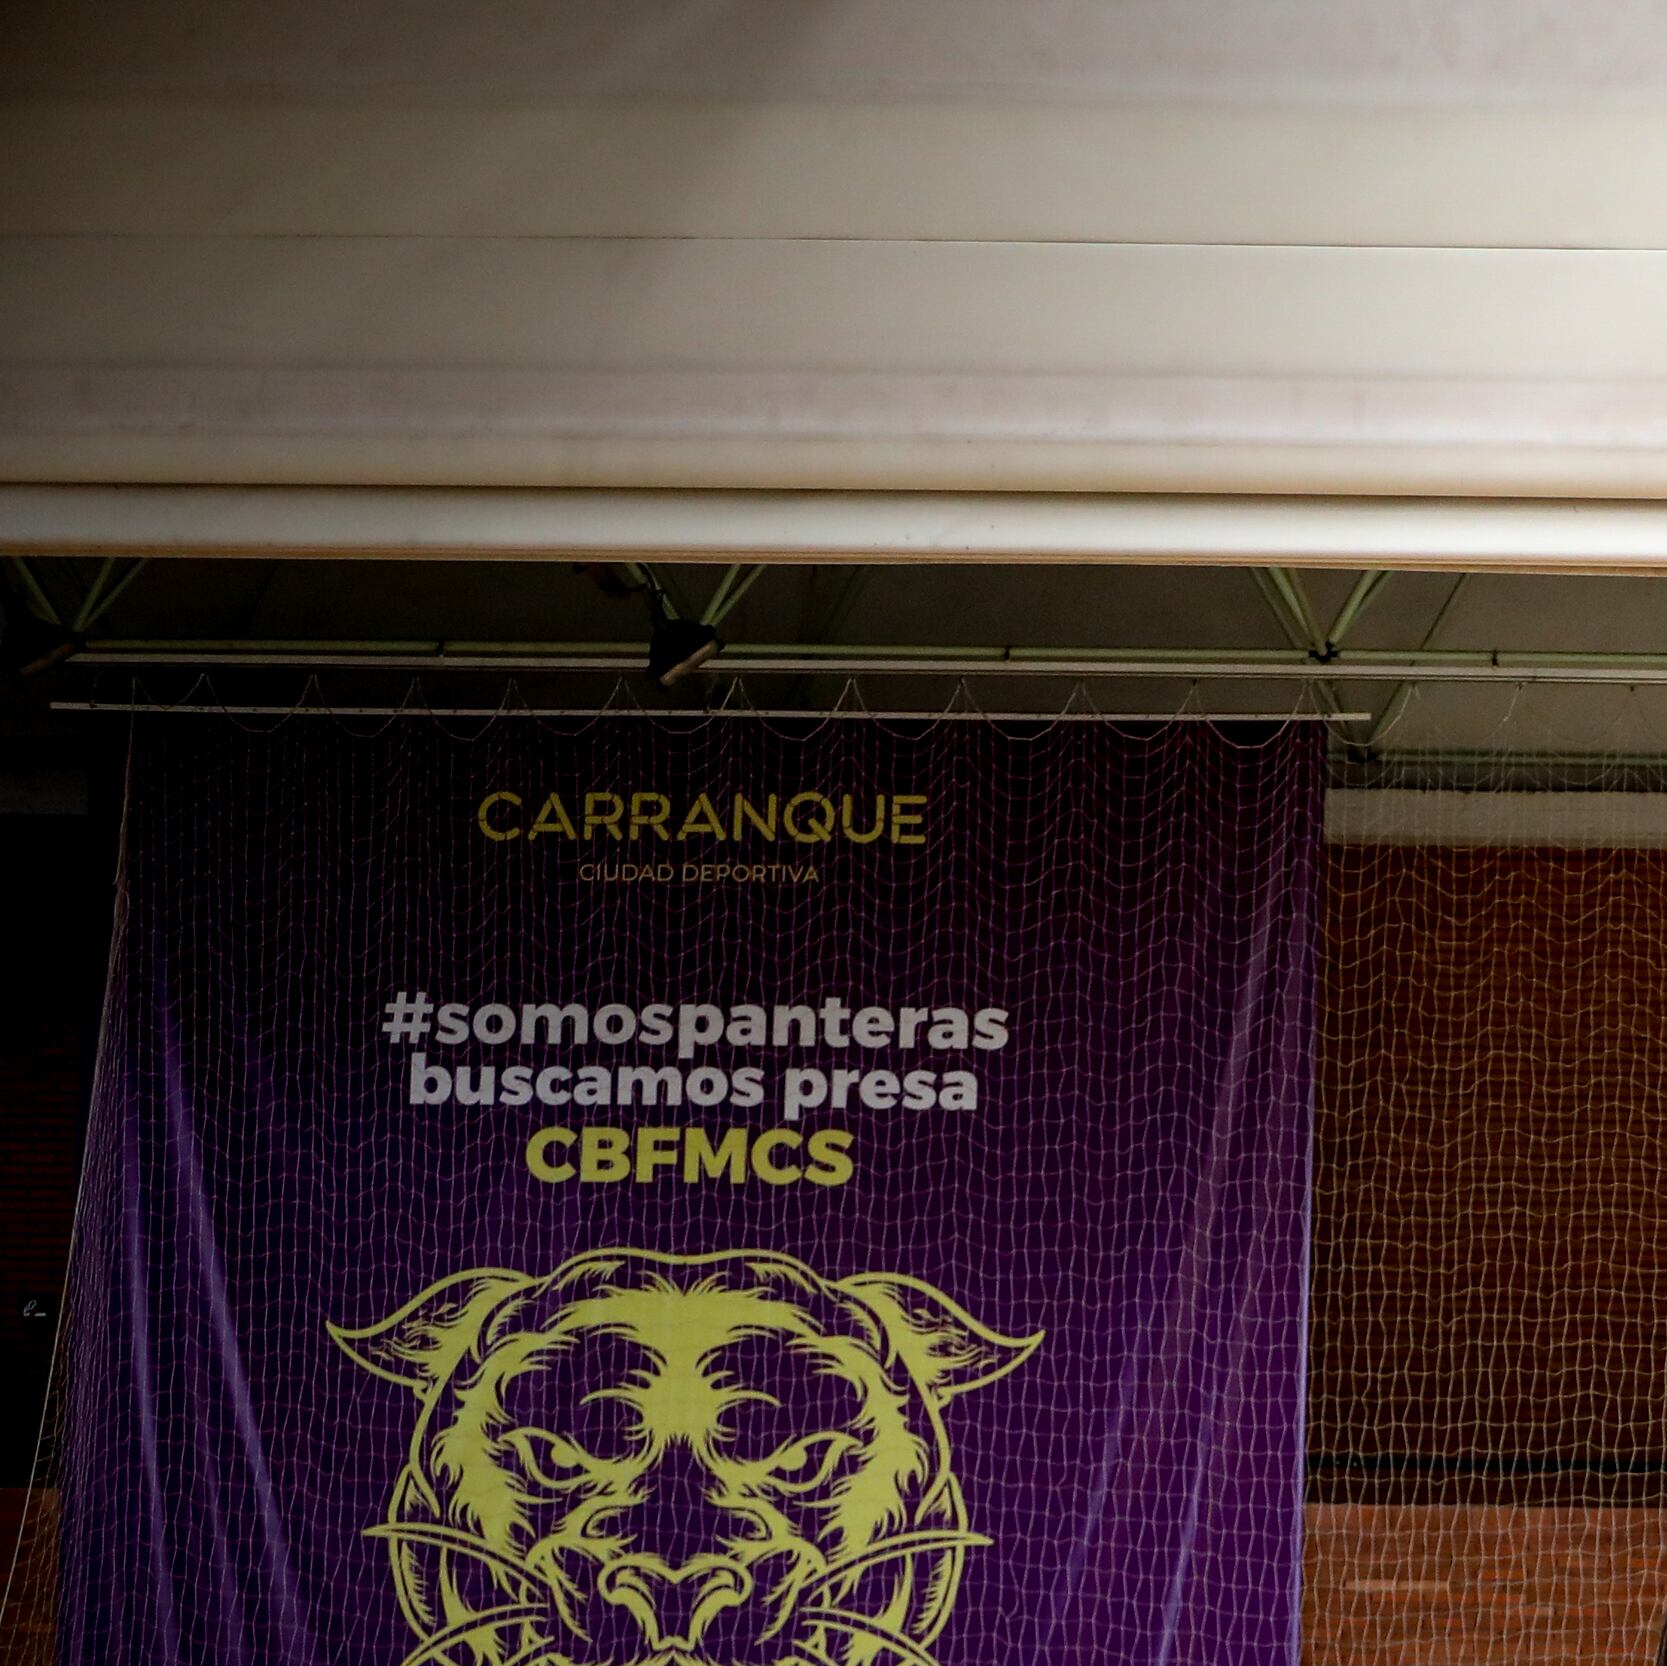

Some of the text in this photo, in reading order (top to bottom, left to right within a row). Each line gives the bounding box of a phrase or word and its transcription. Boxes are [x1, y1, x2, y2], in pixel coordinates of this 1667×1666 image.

[477, 791, 928, 845] CARRANQUE
[579, 863, 820, 884] CIUDAD DEPORTIVA
[381, 991, 1010, 1059] #somospanteras
[410, 1053, 978, 1120] buscamos presa
[525, 1127, 855, 1187] CBFMCS
